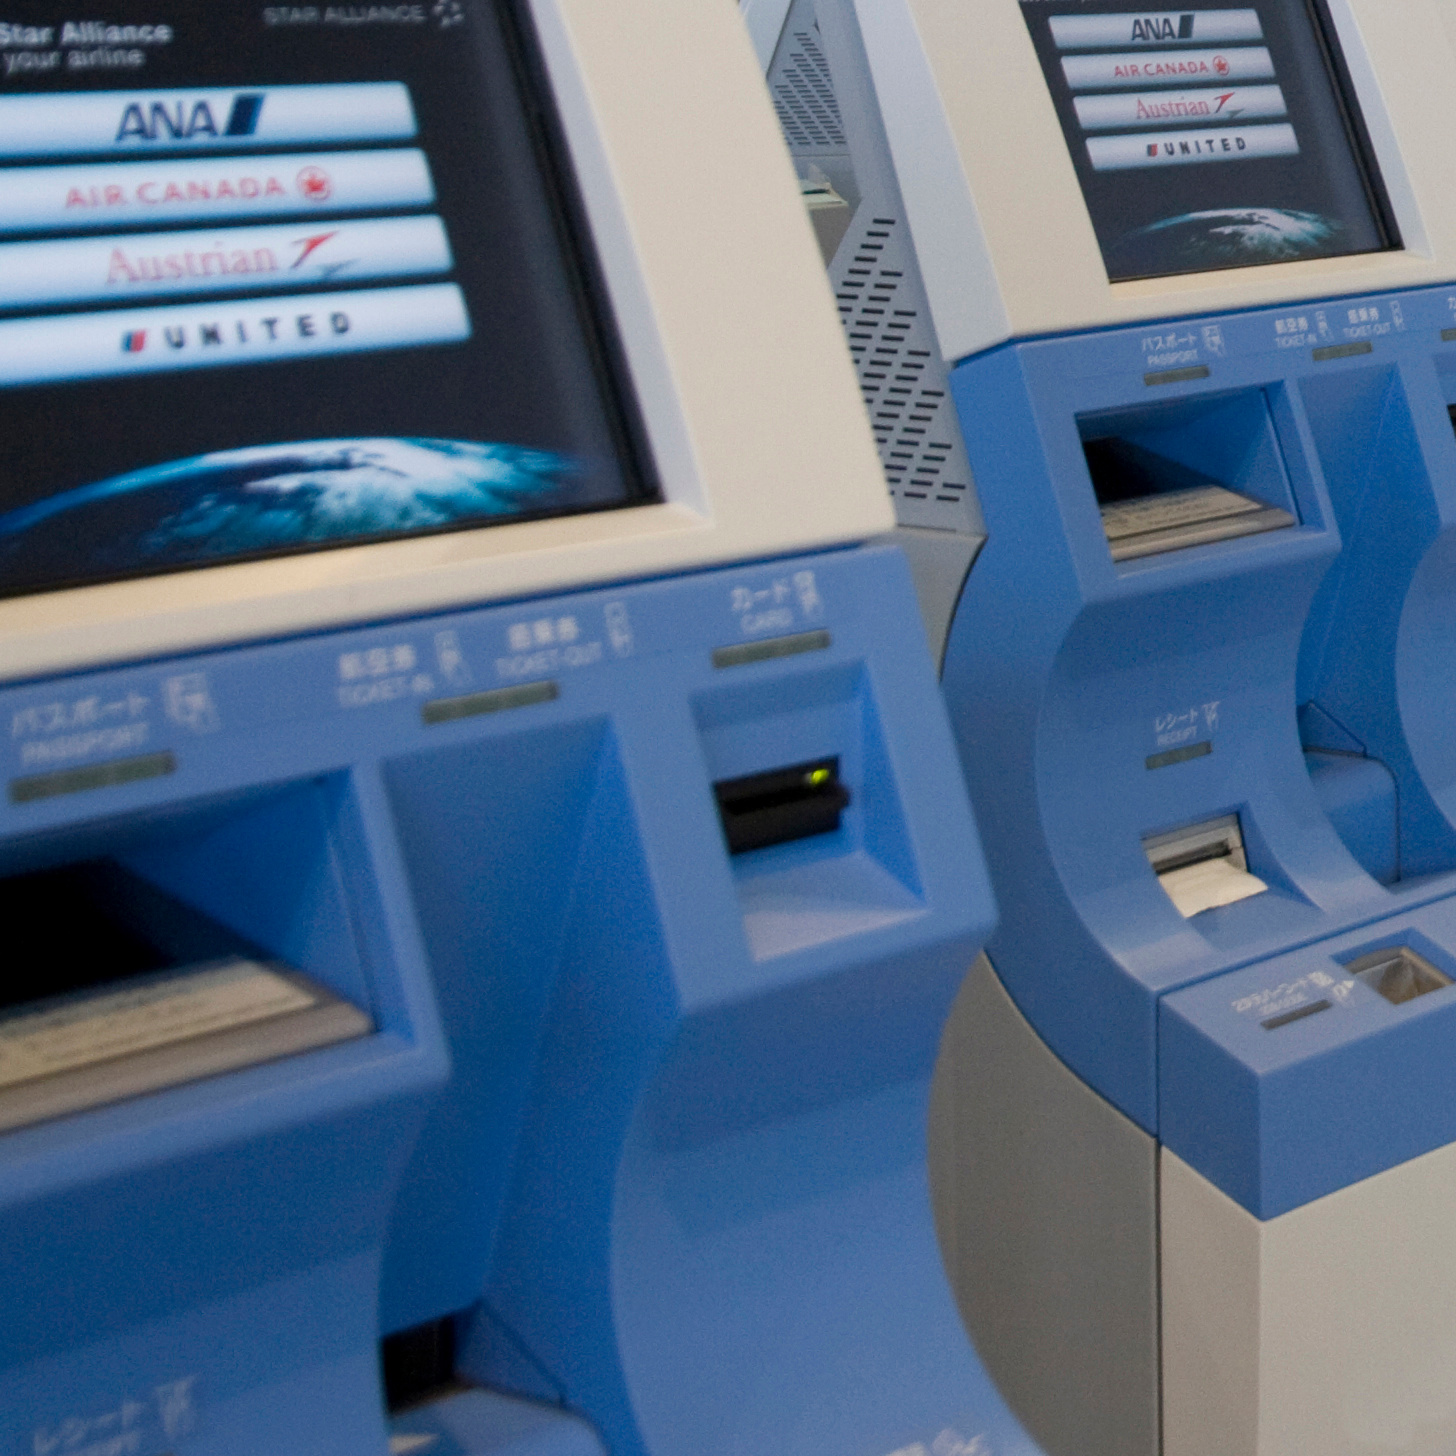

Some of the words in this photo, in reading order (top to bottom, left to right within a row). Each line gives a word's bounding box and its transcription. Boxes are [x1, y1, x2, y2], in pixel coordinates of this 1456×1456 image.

[61, 21, 173, 44] Alliance
[1131, 17, 1178, 41] ANA
[5, 51, 61, 74] your
[67, 49, 145, 69] airline
[1114, 64, 1141, 78] AIR
[1144, 61, 1209, 77] CANADA
[116, 100, 216, 141] ANA
[1136, 97, 1211, 120] Austrian
[1165, 137, 1247, 156] UNITED
[64, 185, 129, 210] AIR
[137, 177, 286, 203] CANADA
[105, 243, 279, 285] Austrian
[166, 311, 351, 350] UNITED
[1142, 332, 1197, 351] パスポート
